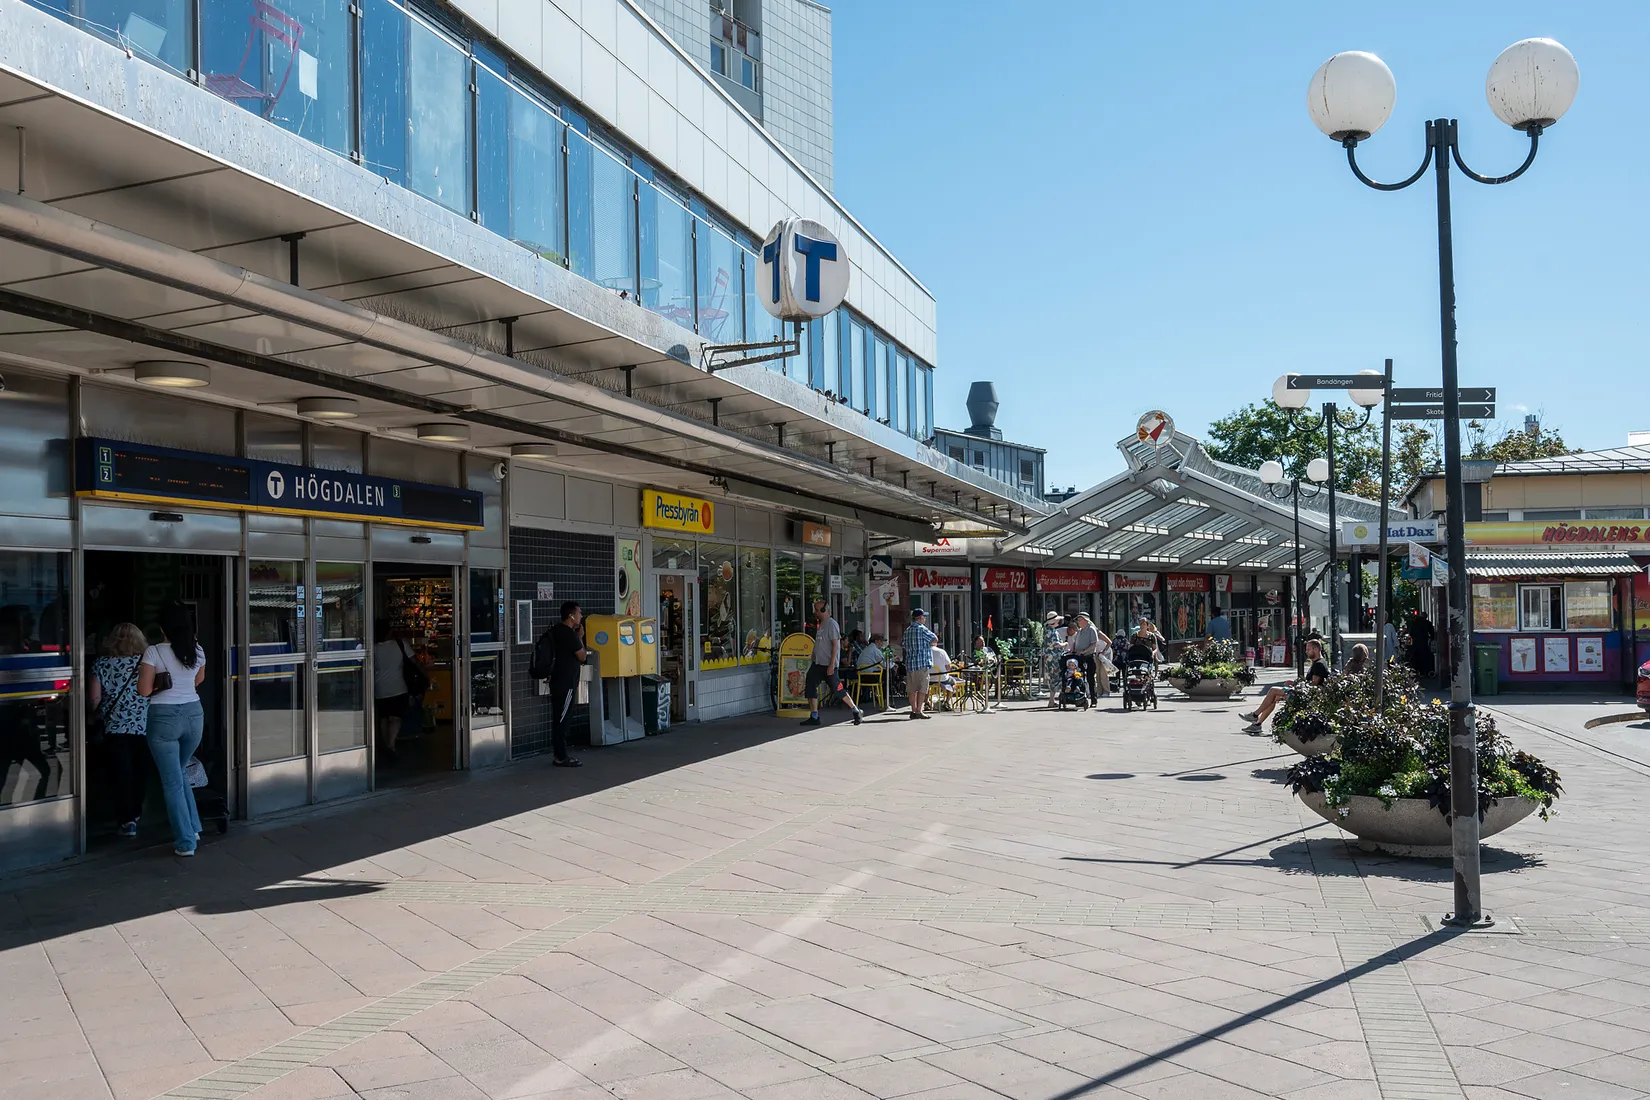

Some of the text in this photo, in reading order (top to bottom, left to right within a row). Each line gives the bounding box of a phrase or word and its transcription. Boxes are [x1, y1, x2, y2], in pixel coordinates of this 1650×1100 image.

[794, 232, 837, 303] T
[1316, 378, 1354, 386] Bandängen
[103, 470, 109, 480] 2
[295, 473, 384, 507] HÖGDALEN
[656, 495, 699, 526] Pressbyrån
[1406, 526, 1435, 537] Dax
[1541, 522, 1641, 542] HÖGDALENS
[922, 546, 961, 554] Supermarket
[913, 568, 930, 588] ICA
[1010, 571, 1025, 588] 7-22
